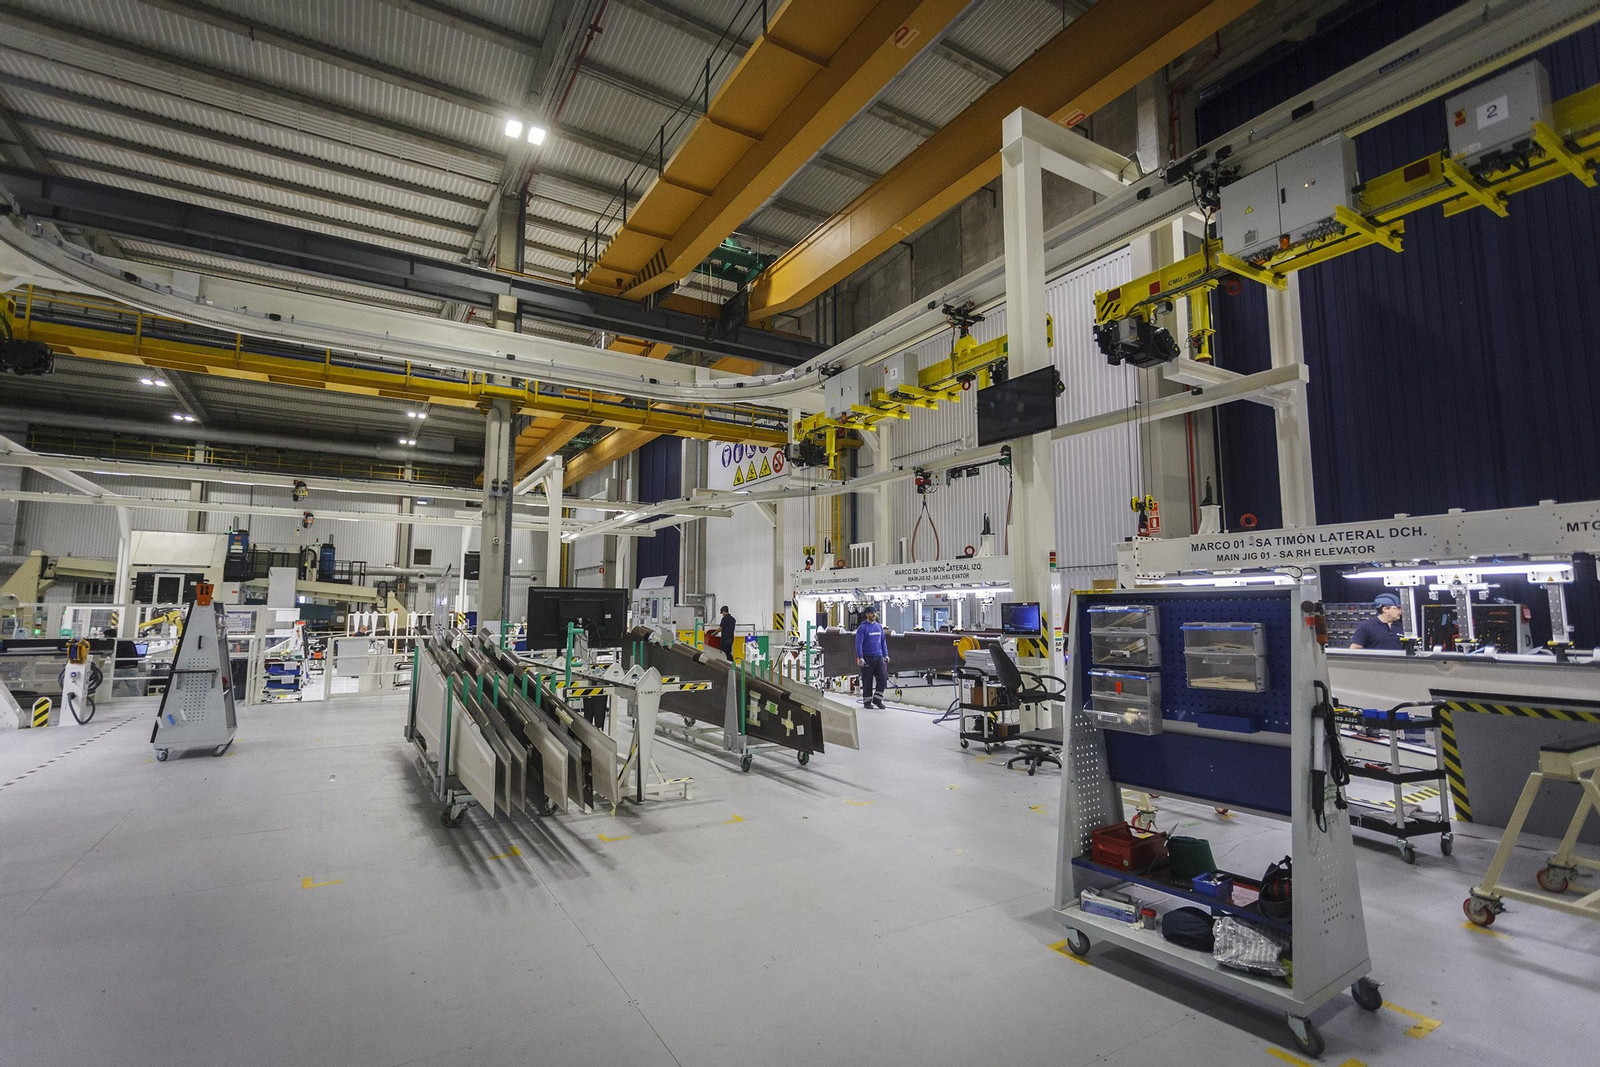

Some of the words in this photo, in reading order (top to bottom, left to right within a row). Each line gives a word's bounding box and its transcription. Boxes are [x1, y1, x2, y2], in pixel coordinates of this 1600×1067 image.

[1486, 104, 1498, 119] 2
[1168, 276, 1183, 286] CMU
[1187, 269, 1202, 279] 5000
[1191, 541, 1231, 552] MARCO
[1233, 540, 1245, 549] 01
[1255, 538, 1272, 547] SA
[1274, 533, 1315, 545] TIMÓN
[1319, 529, 1385, 543] LATERAL
[1389, 526, 1427, 538] DCH.
[1216, 553, 1240, 562] MAIN
[1242, 552, 1258, 560] JIG
[1260, 551, 1270, 560] 01
[1279, 550, 1294, 558] SA
[1296, 549, 1311, 557] RH
[1314, 545, 1375, 556] ELEVATOR
